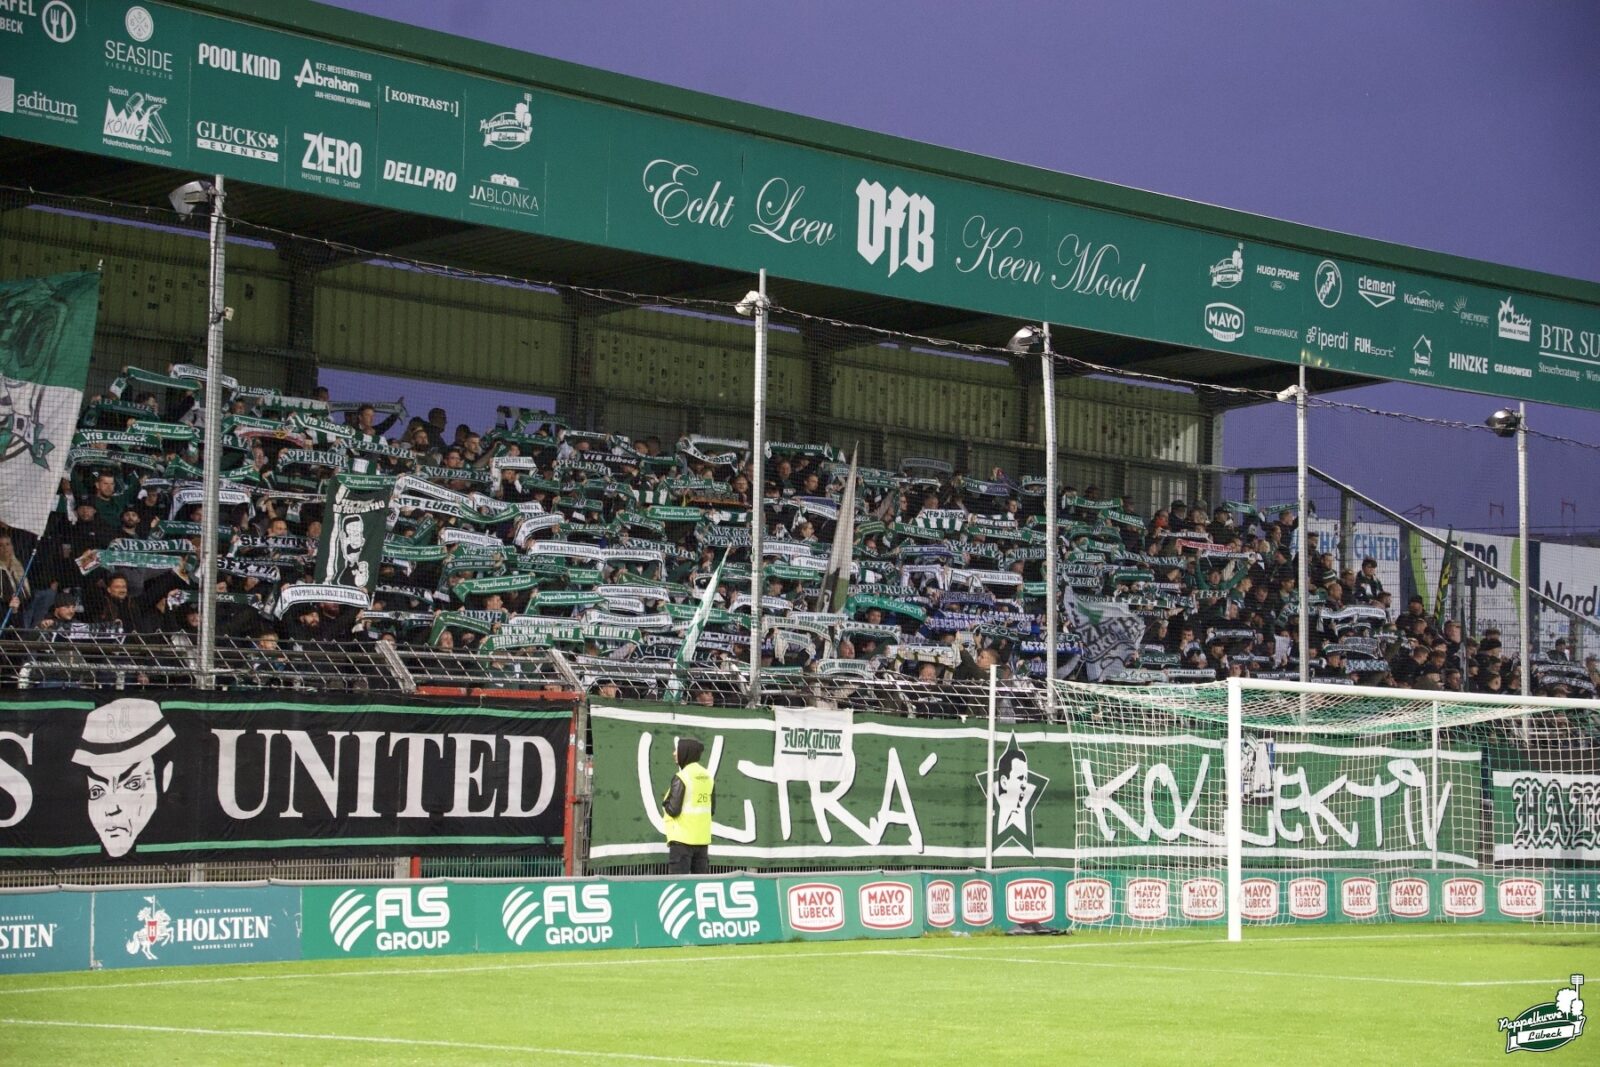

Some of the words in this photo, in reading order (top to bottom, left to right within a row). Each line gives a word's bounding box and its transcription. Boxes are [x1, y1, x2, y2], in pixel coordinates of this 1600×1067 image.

[105, 41, 173, 72] SEASIDE
[294, 58, 359, 94] Abraham
[16, 90, 78, 118] aditum
[105, 118, 144, 139] KÖNIG
[210, 142, 267, 158] EVENTS
[383, 159, 457, 192] DELLPRO
[469, 184, 539, 211] JABLONKA
[642, 158, 735, 229] Echt
[748, 177, 836, 247] Leev
[955, 215, 1044, 285] Keen
[1051, 233, 1146, 302] Mood
[1256, 264, 1277, 276] HUGO
[1277, 268, 1300, 281] PFOHE
[1358, 275, 1396, 295] clement
[1208, 310, 1241, 330] MAYO
[1317, 327, 1349, 351] iperdi
[1540, 323, 1574, 353] BTR
[1449, 352, 1488, 374] HINZKE
[1494, 363, 1532, 377] GRABOWSKI
[82, 432, 103, 441] VfB
[107, 432, 148, 443] Lübeck
[583, 452, 602, 461] VfB
[142, 537, 170, 551] DER
[1354, 534, 1398, 562] CENTER
[290, 589, 338, 599] PAPPELKURVE
[339, 591, 365, 601] LÜBECK
[784, 729, 841, 750] SUBKULTUR
[211, 728, 557, 820] UNITED
[697, 793, 709, 804] 26
[868, 889, 905, 904] MAYO
[931, 888, 950, 902] MAYO
[966, 887, 988, 901] MAYO
[1014, 886, 1047, 900] MAYO
[1075, 886, 1105, 899] MAYO
[1134, 885, 1161, 898] MAYO
[1244, 885, 1271, 897] MAYO
[1295, 885, 1321, 897] MAYO
[1348, 884, 1372, 896] MAYO
[1395, 884, 1423, 896] MAYO
[1449, 884, 1477, 896] MAYO
[1505, 884, 1537, 896] MAYO
[543, 884, 613, 925] FLS
[694, 880, 760, 921] FLS
[797, 891, 835, 906] MAYO
[1014, 900, 1047, 911] LÜBECK
[376, 886, 449, 930] FLS
[798, 906, 835, 918] LÜBECK
[869, 905, 905, 917] LÜBECK
[966, 902, 988, 913] LÜBECK
[177, 916, 270, 942] HOLSTEN
[545, 925, 614, 945] GROUP
[699, 920, 761, 940] GROUP
[376, 931, 450, 951] GROUP
